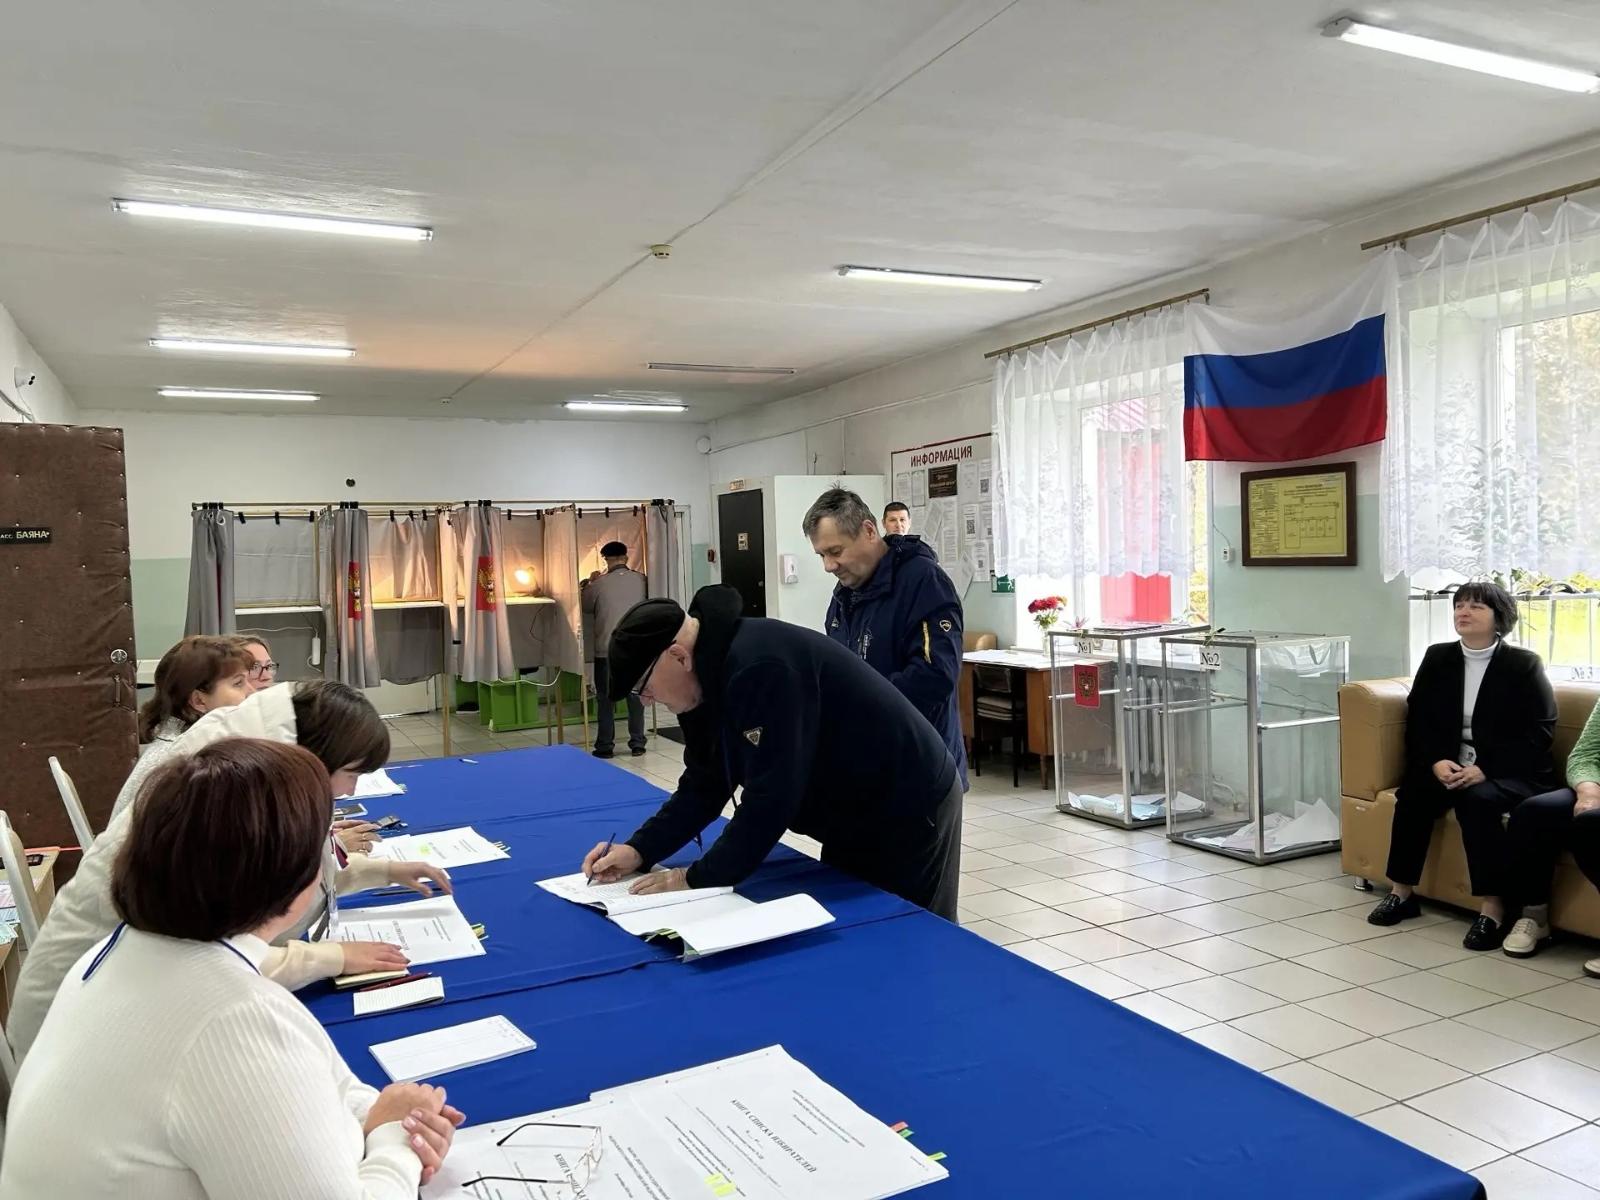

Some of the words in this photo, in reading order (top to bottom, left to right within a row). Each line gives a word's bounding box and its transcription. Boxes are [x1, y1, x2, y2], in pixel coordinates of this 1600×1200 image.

[911, 445, 972, 467] ИНФОРМАЦИЯ
[16, 531, 47, 539] БАЯНА
[1200, 652, 1220, 666] №2
